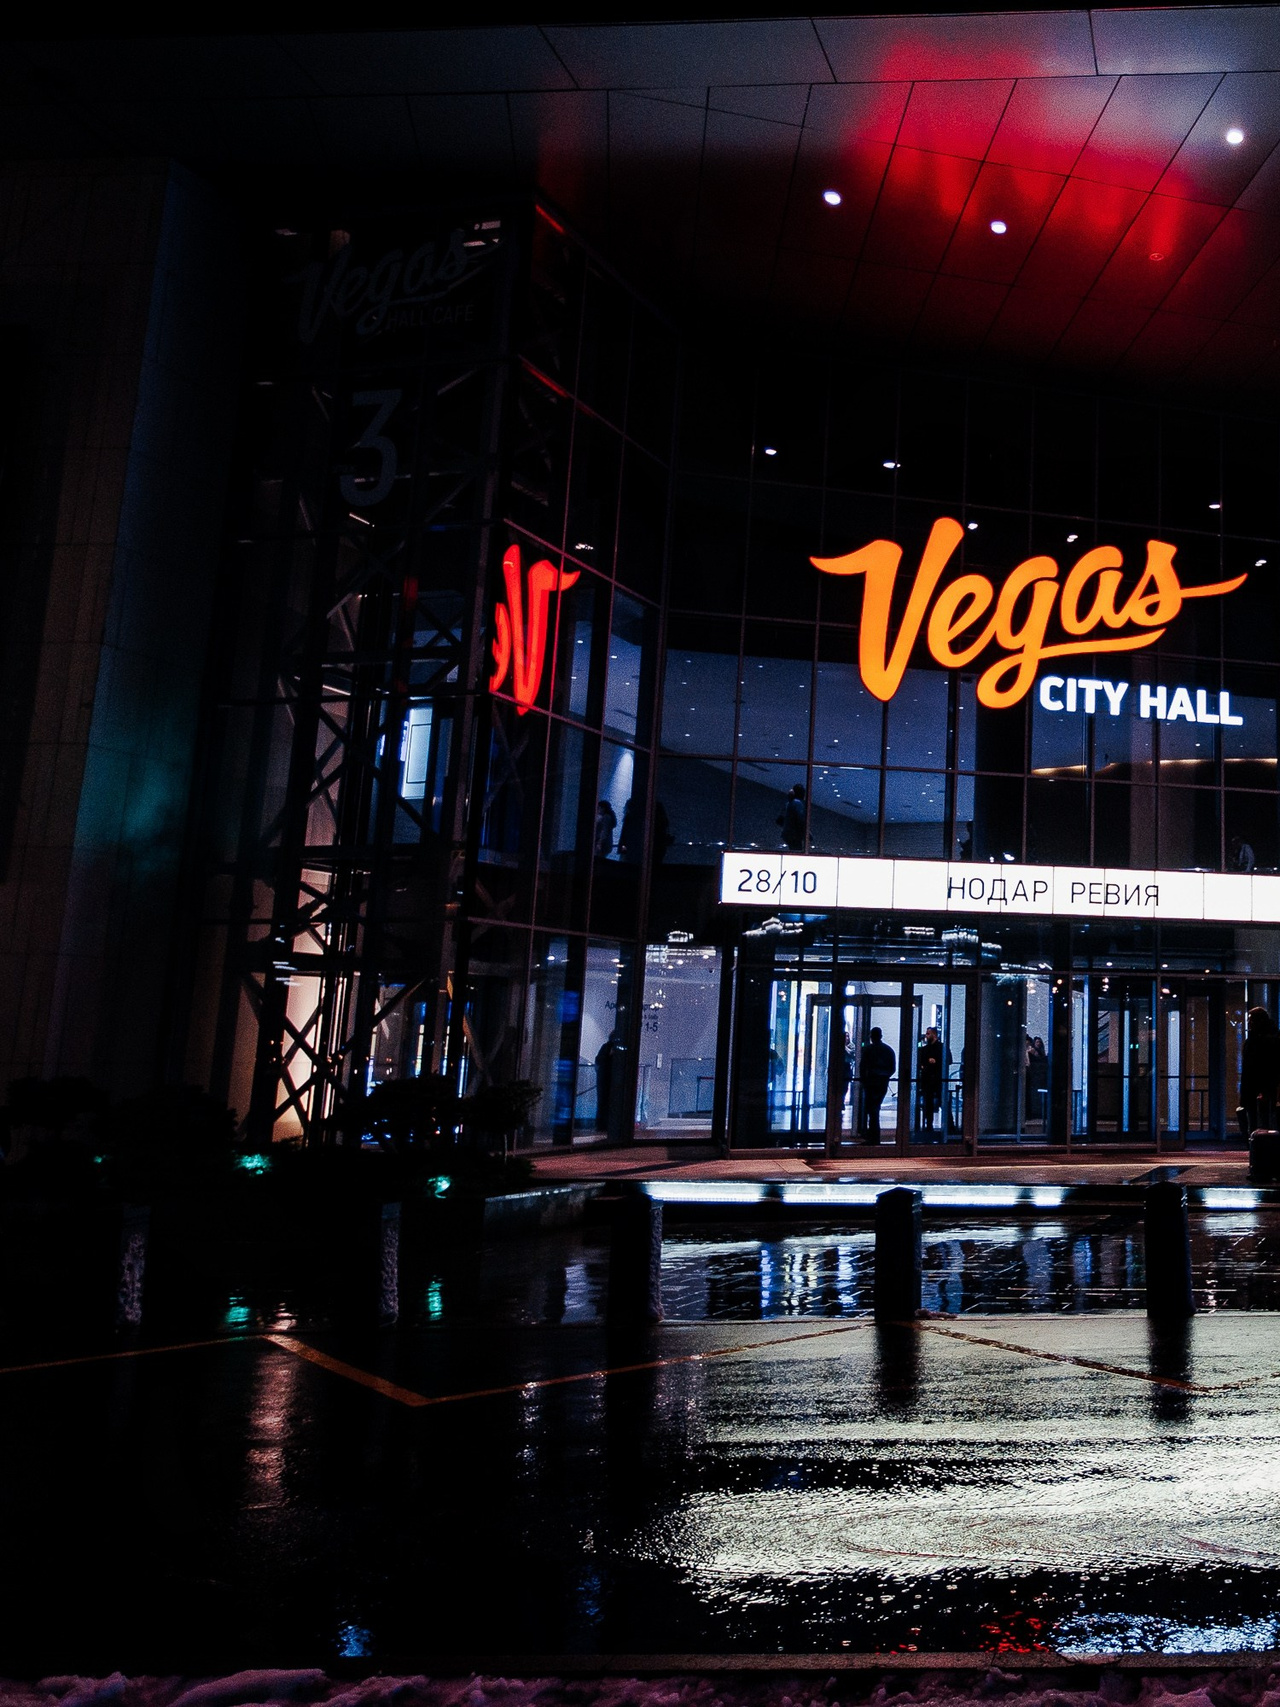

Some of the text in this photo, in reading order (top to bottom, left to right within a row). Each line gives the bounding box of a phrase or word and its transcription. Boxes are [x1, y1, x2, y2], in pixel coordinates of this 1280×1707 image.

[283, 227, 505, 344] Vegas
[386, 310, 427, 331] HALL
[340, 389, 402, 508] 3
[810, 517, 1247, 708] Vegas
[1039, 676, 1244, 726] CITY HALL
[737, 869, 1159, 907] 28/10 НОДАР РЕВИЯ
